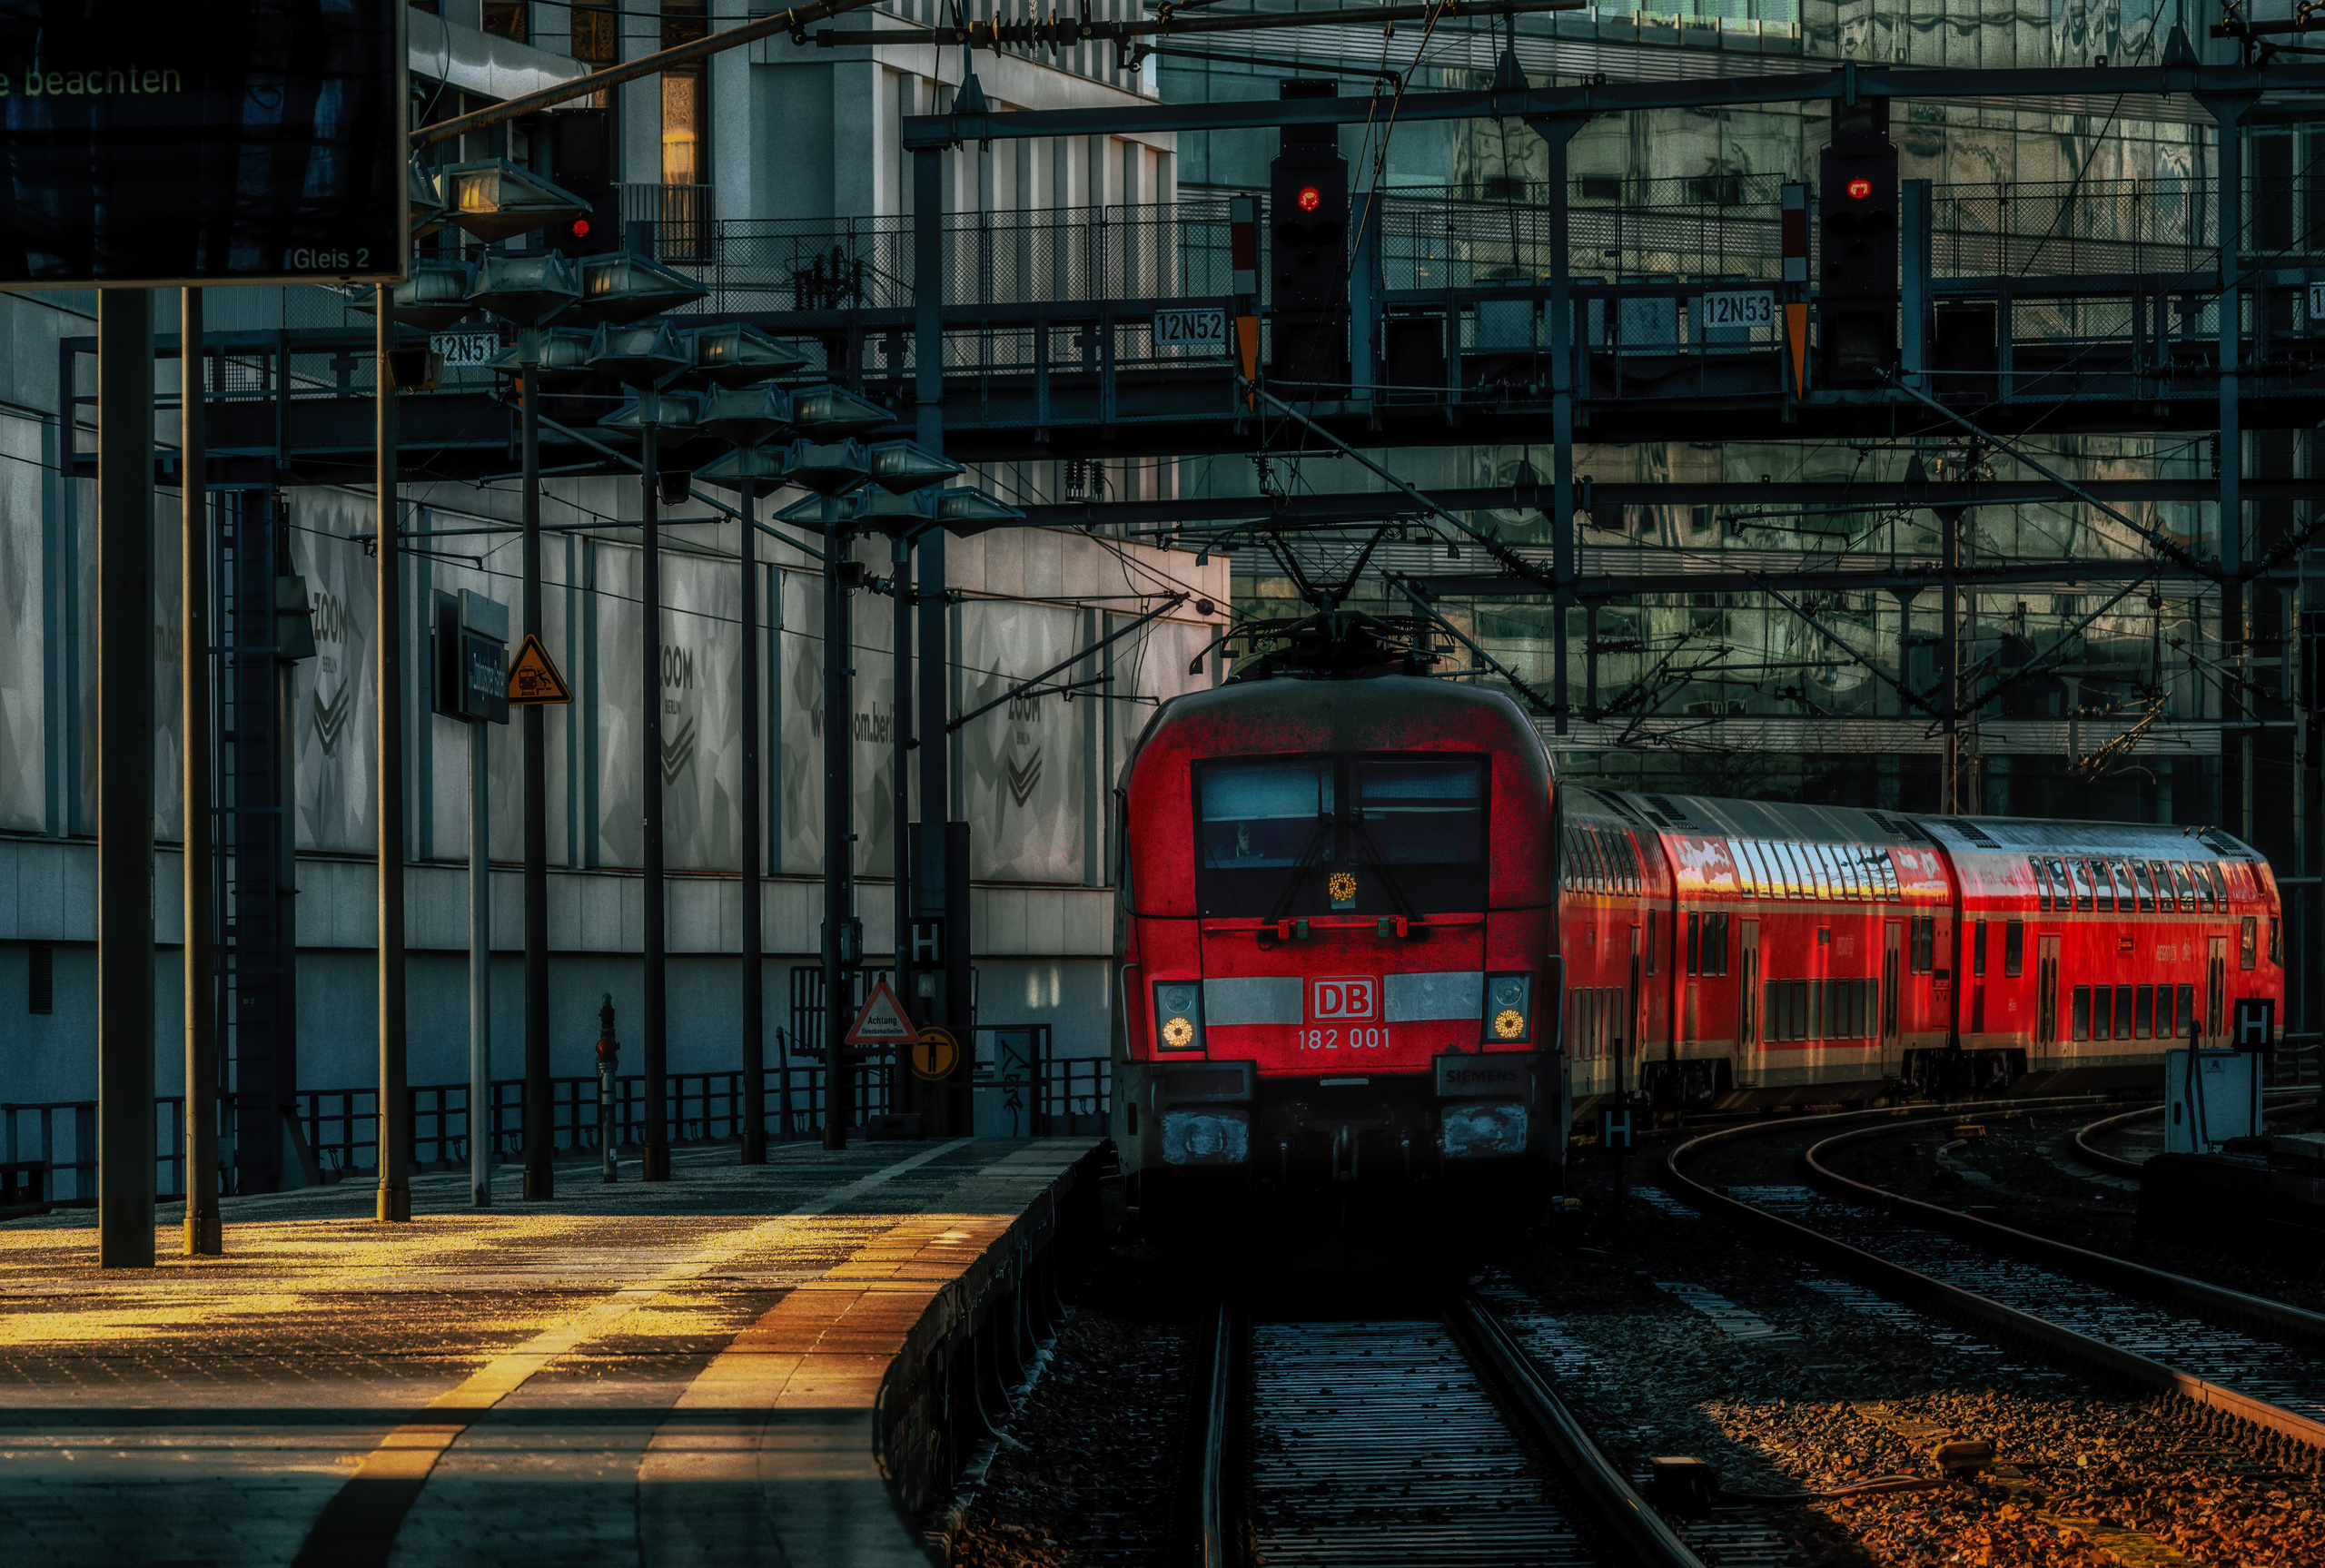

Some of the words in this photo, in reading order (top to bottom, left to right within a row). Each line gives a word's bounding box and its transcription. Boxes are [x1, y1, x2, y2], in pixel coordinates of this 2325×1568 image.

[25, 62, 182, 96] beachten
[293, 248, 350, 269] Gleis
[356, 247, 370, 268] 2
[1707, 296, 1770, 322] 12N53
[1158, 313, 1222, 340] 12N52
[435, 336, 494, 361] 12N51
[314, 592, 348, 645] ZOOM
[912, 923, 939, 962] H
[1319, 984, 1370, 1014] DB
[867, 1016, 897, 1025] Achtung
[2241, 1005, 2268, 1043] H
[1298, 1029, 1339, 1050] 182
[1350, 1028, 1390, 1049] 001
[1446, 1069, 1518, 1083] SIEMENS
[1605, 1110, 1630, 1147] H
